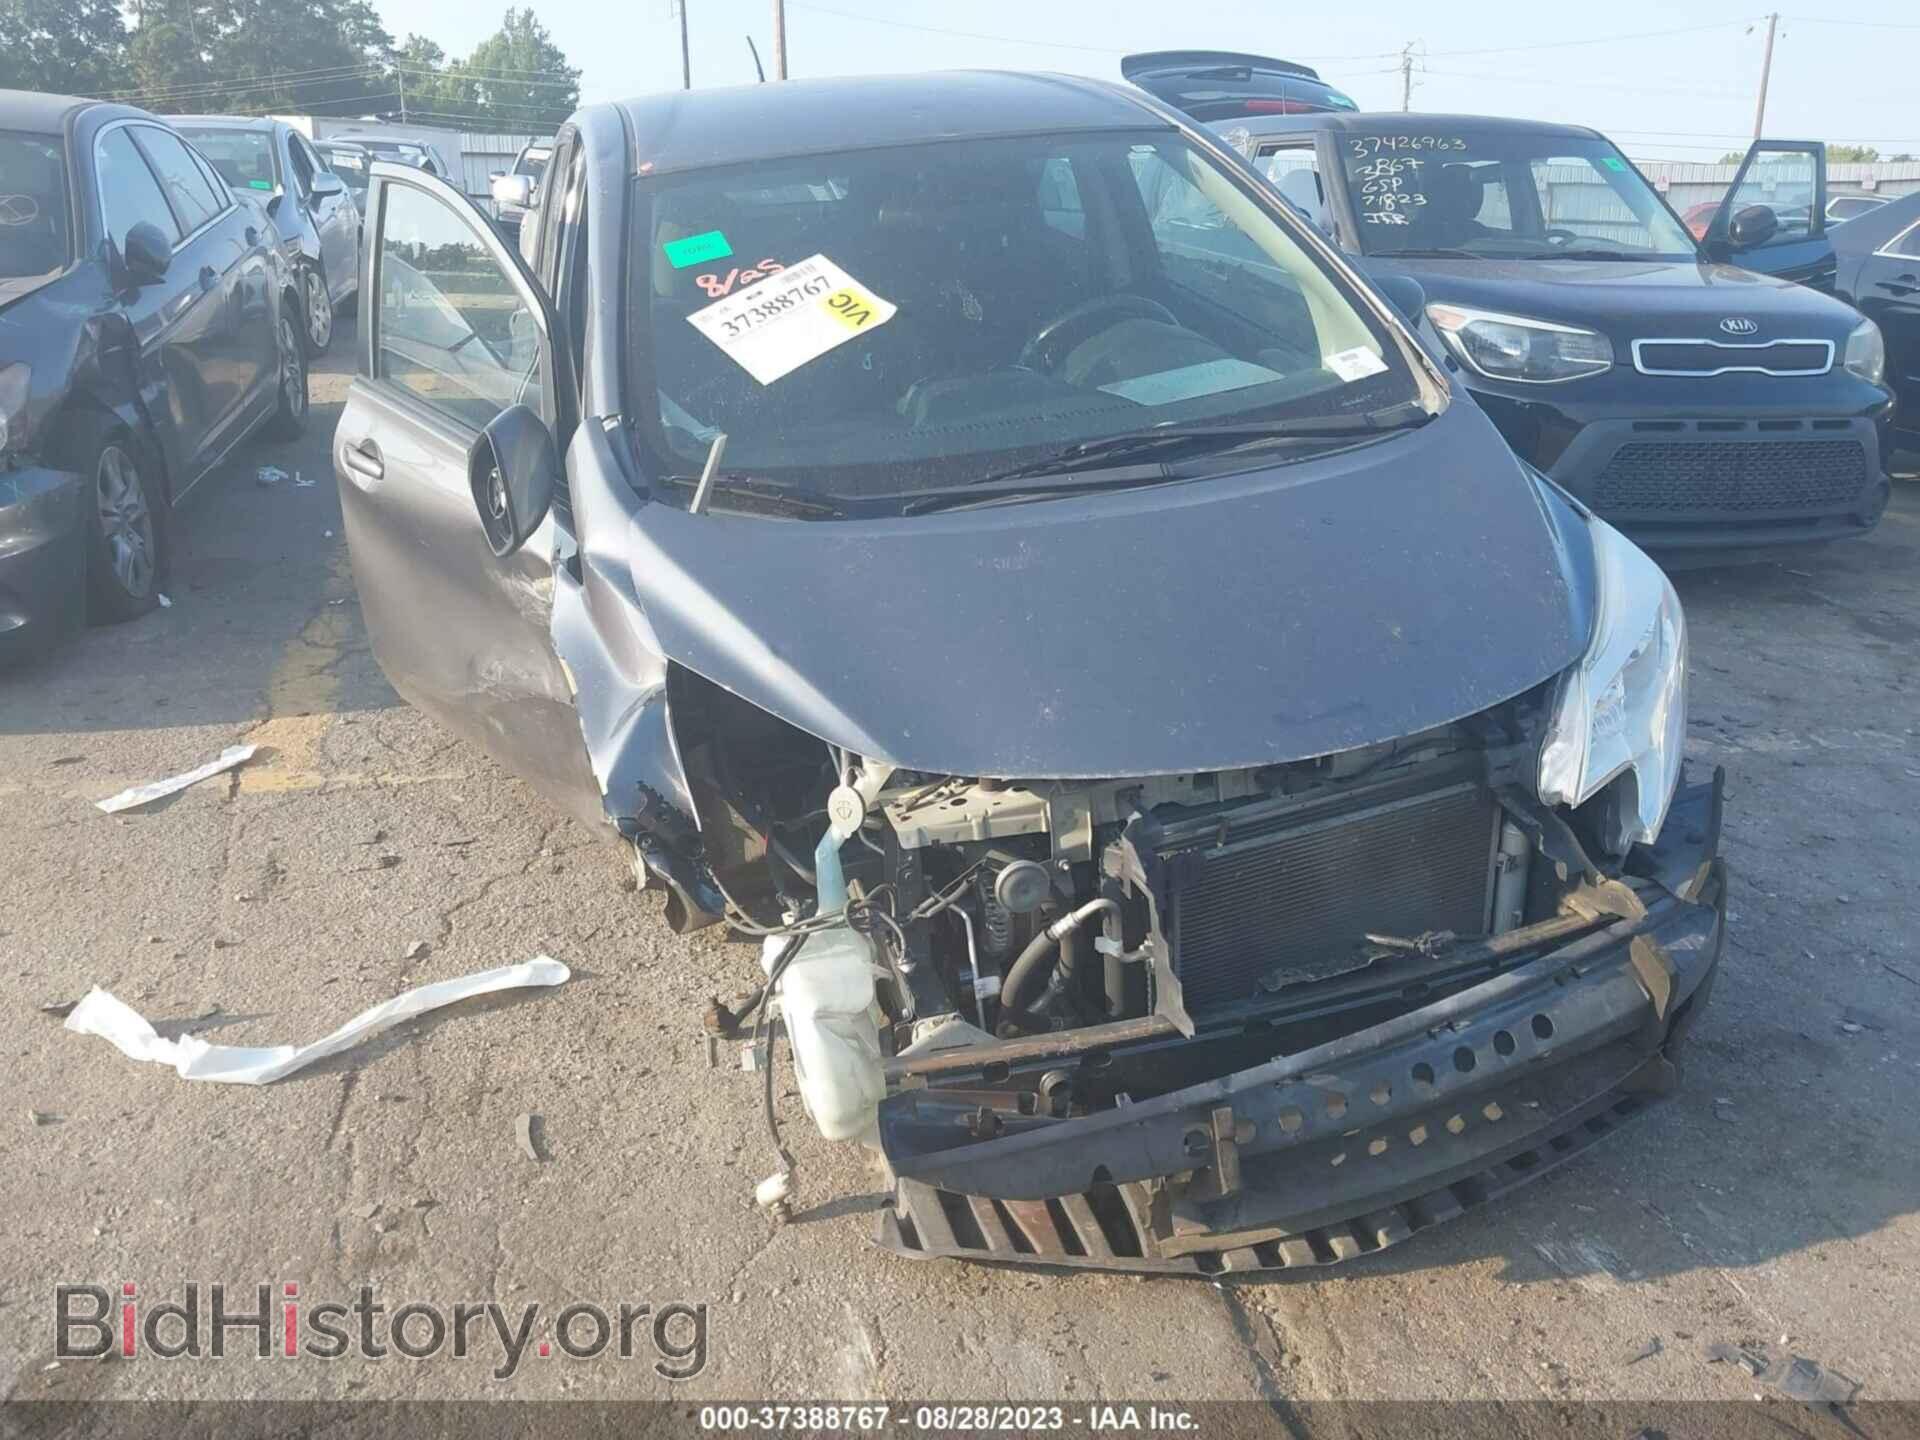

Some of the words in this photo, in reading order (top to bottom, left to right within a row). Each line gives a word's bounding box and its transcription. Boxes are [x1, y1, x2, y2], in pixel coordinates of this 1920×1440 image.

[1350, 136, 1467, 158] 37426963
[721, 275, 832, 337] 37388767
[1725, 319, 1755, 331] KIA
